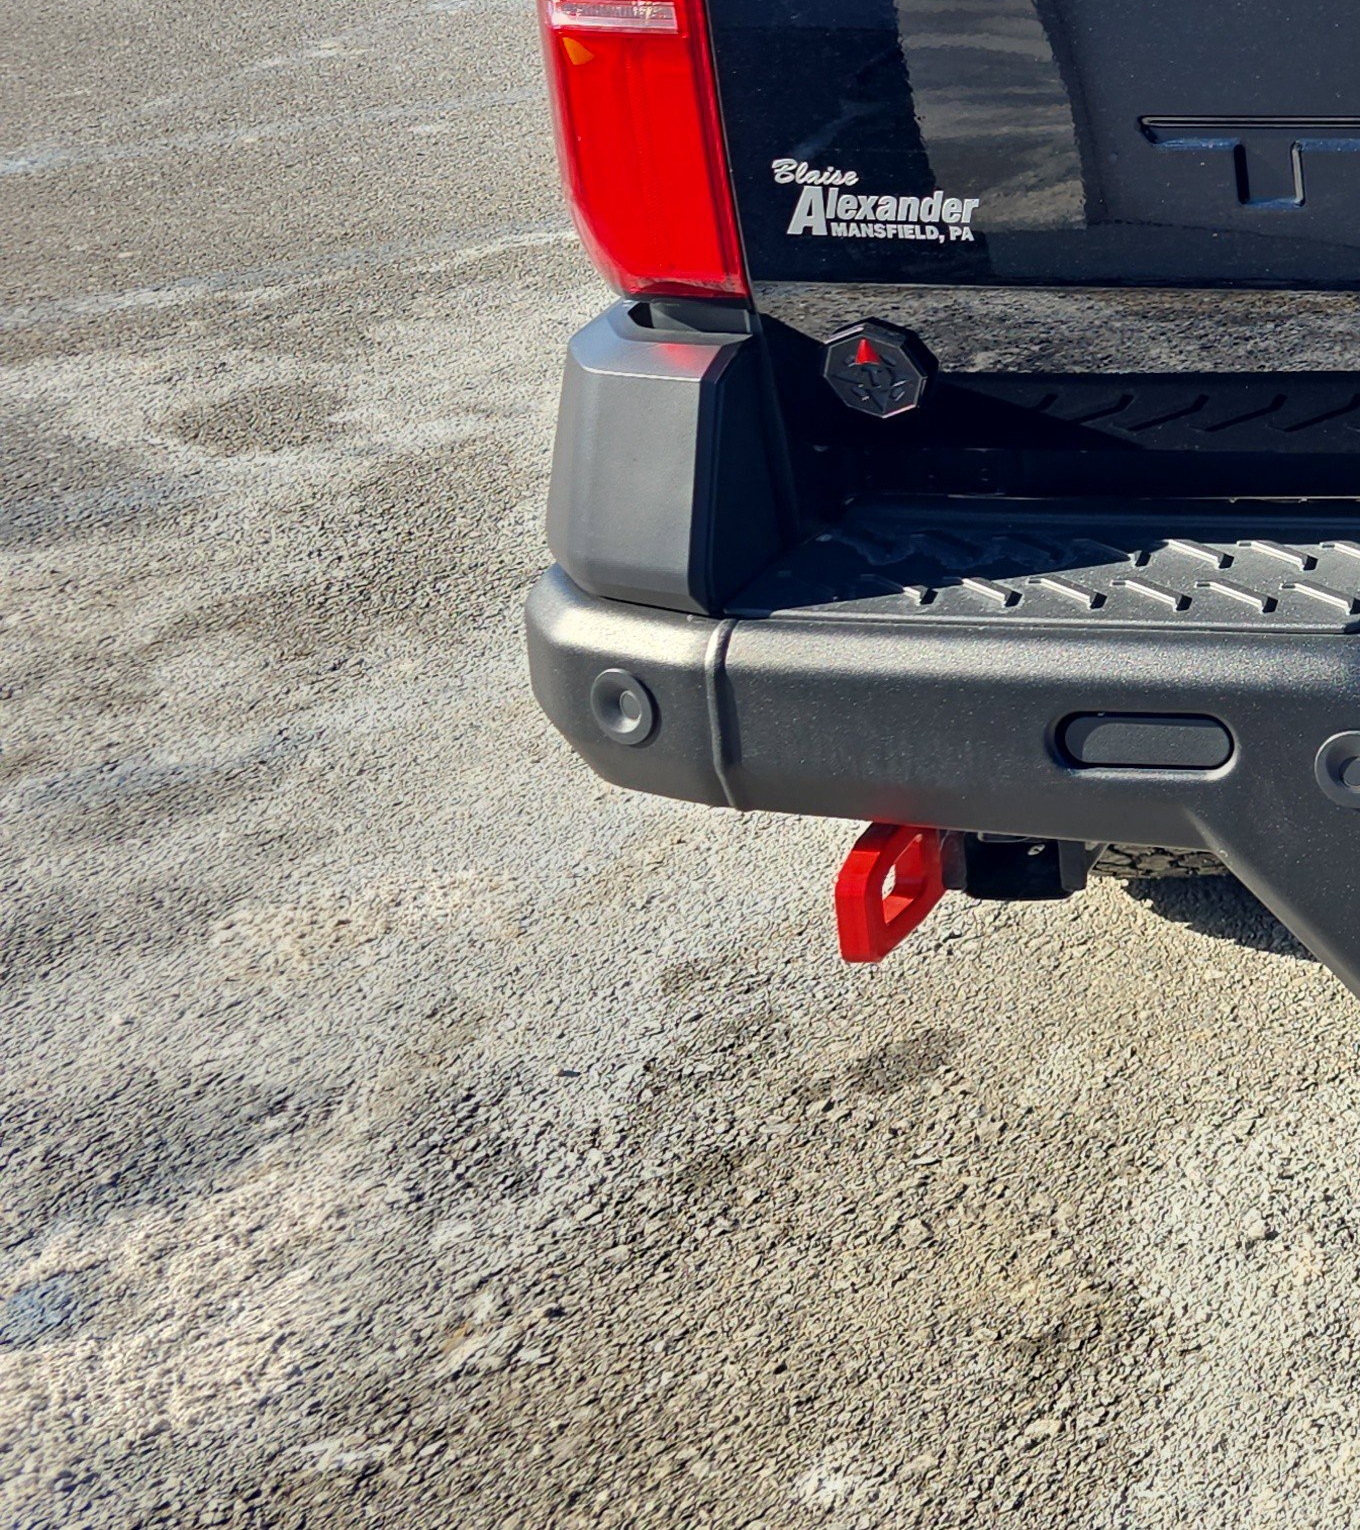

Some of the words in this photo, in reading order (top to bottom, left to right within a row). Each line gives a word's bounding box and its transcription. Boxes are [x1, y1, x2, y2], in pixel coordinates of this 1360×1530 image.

[771, 158, 860, 186] Blaise
[786, 185, 981, 237] Alexander
[830, 221, 945, 244] MANSFIELD,
[950, 225, 975, 242] PA
